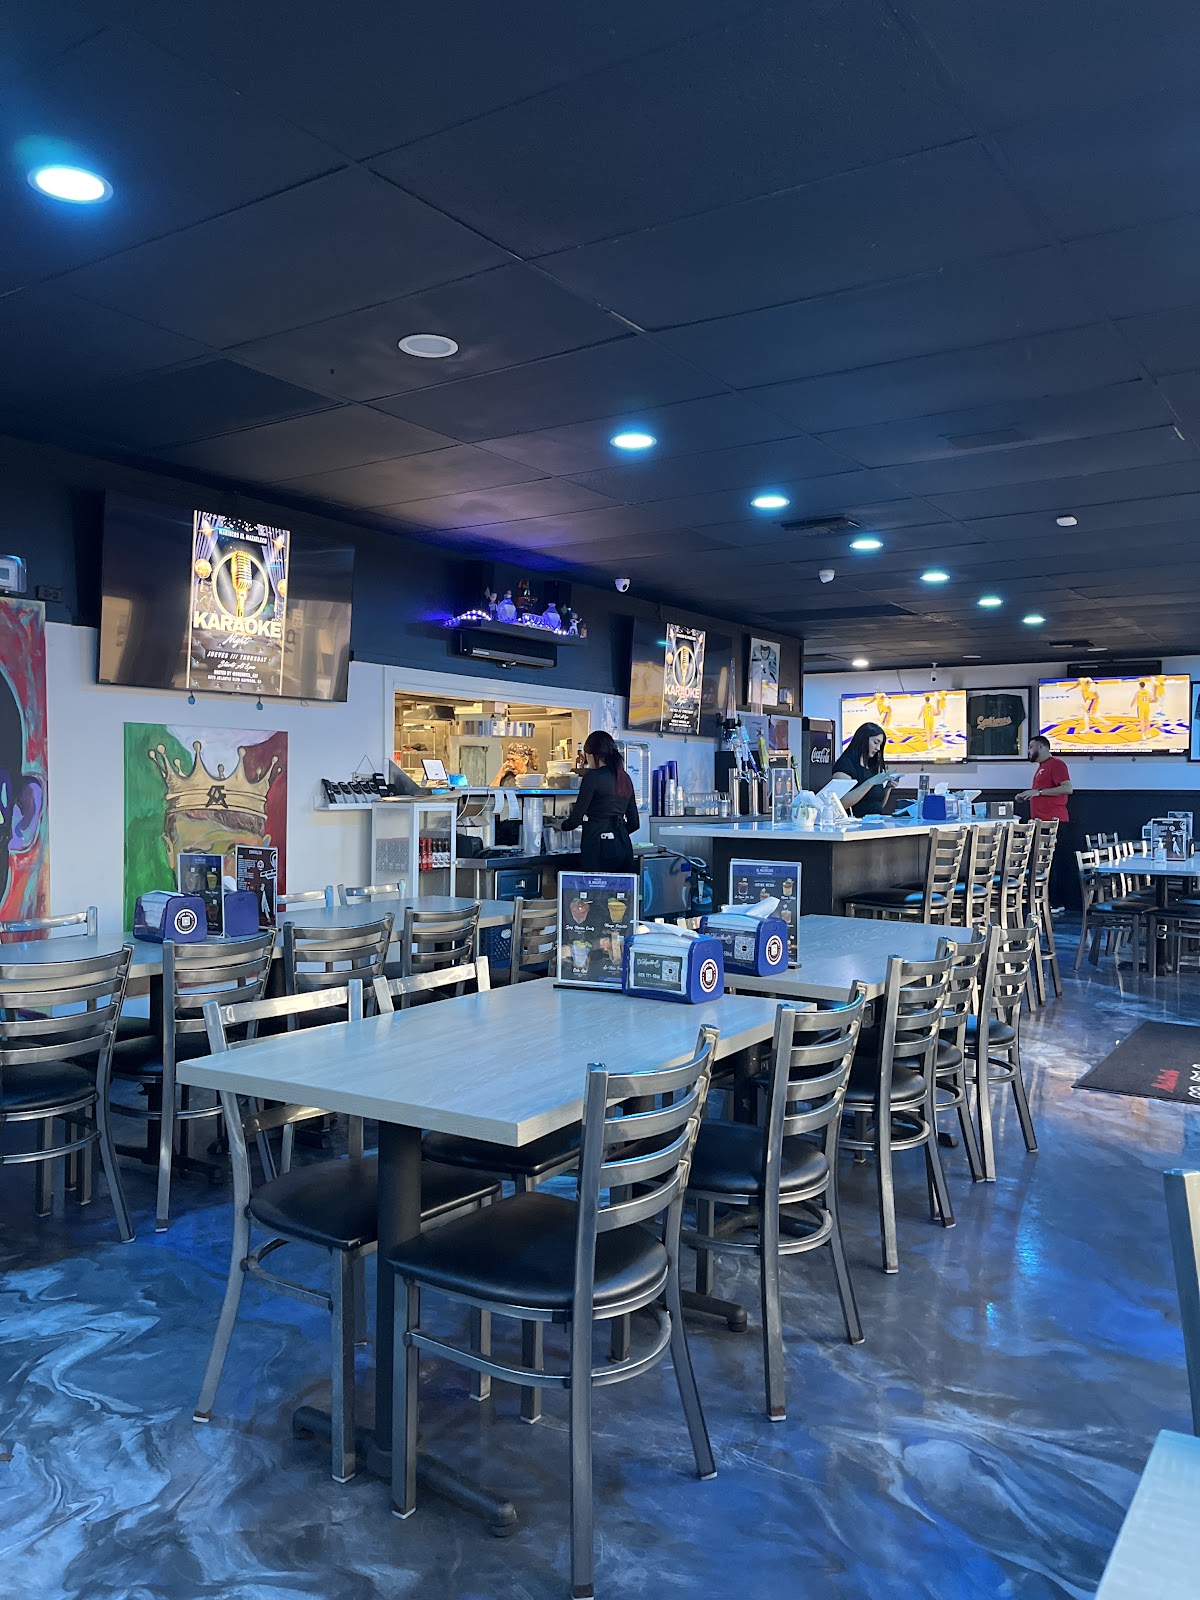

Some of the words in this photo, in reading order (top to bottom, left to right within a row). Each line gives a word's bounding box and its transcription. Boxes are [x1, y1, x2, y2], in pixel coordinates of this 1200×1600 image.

[193, 611, 282, 639] KARAOKE
[222, 633, 252, 648] Night
[665, 683, 701, 699] KARAOKE
